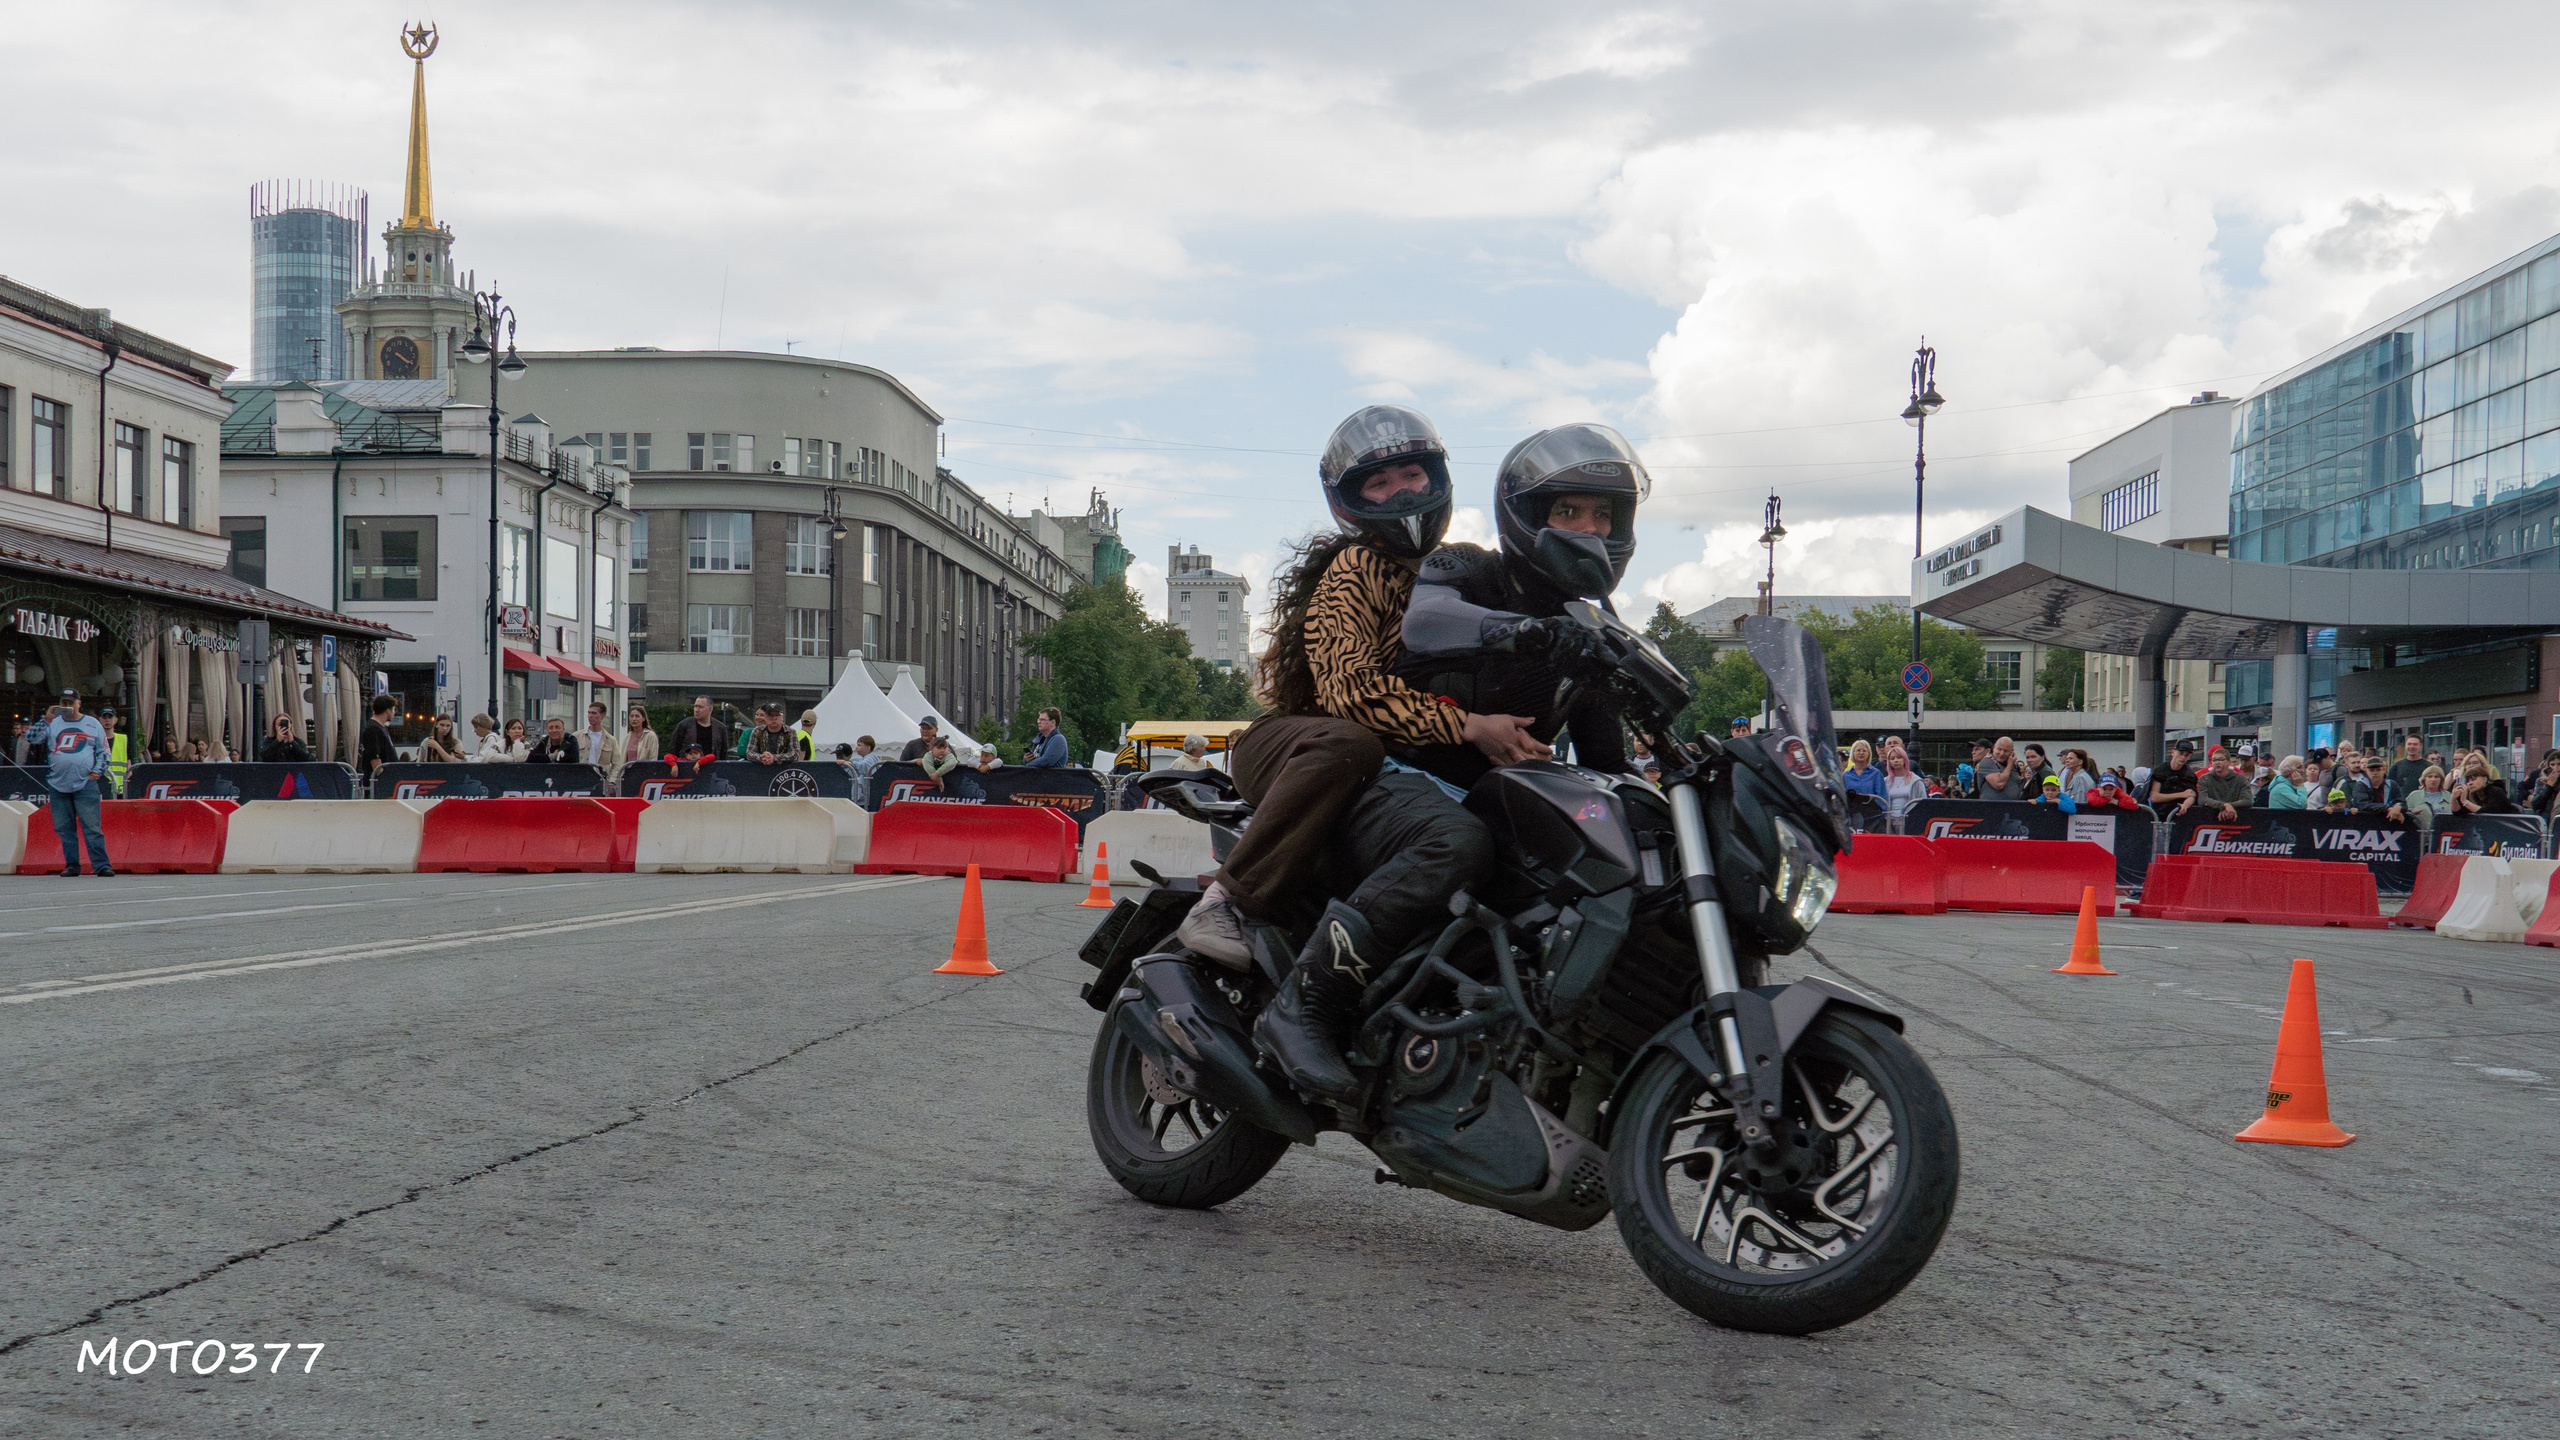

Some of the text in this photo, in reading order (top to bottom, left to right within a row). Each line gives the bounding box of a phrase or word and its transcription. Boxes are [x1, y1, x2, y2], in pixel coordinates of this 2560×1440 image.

[17, 608, 96, 643] ТАБАК 18+
[325, 639, 333, 668] P
[776, 771, 811, 784] 100.4 FM
[2312, 828, 2405, 851] VIRAX
[2349, 852, 2401, 862] CAPITAL
[2500, 841, 2538, 860] билайн
